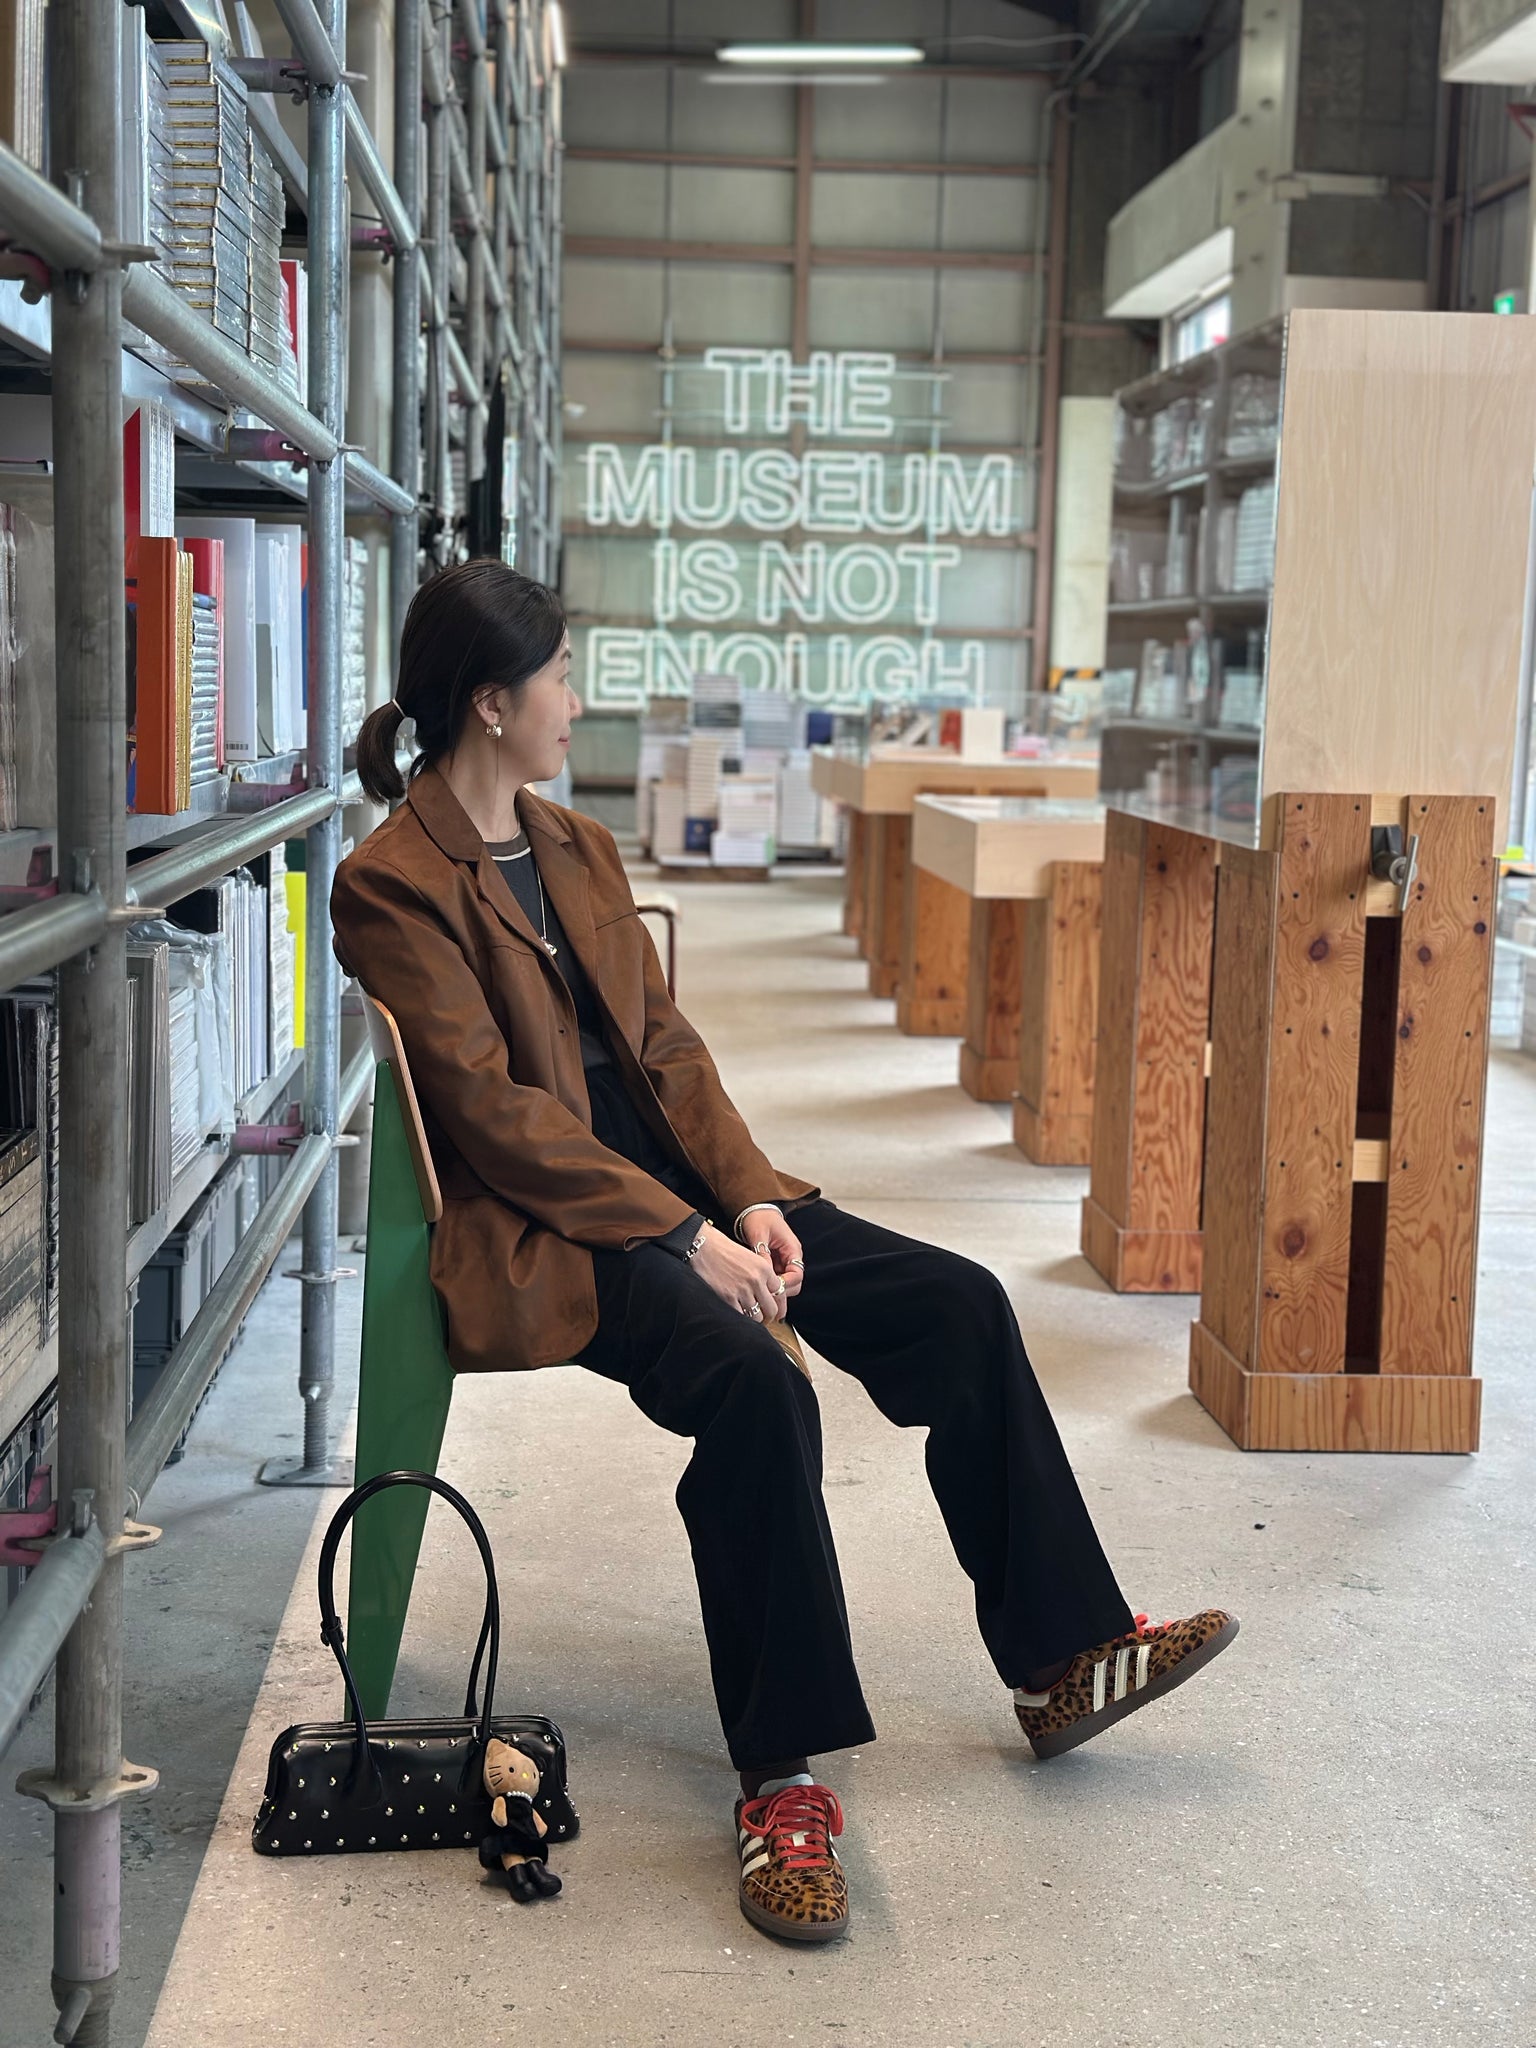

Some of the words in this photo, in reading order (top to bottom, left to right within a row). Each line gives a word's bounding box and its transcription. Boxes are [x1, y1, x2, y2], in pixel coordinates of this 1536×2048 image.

[704, 347, 896, 437] THE
[586, 444, 1013, 536] MUSEUM
[653, 538, 743, 623] IS
[756, 541, 961, 626] NOT
[585, 627, 985, 714] ENOUGH
